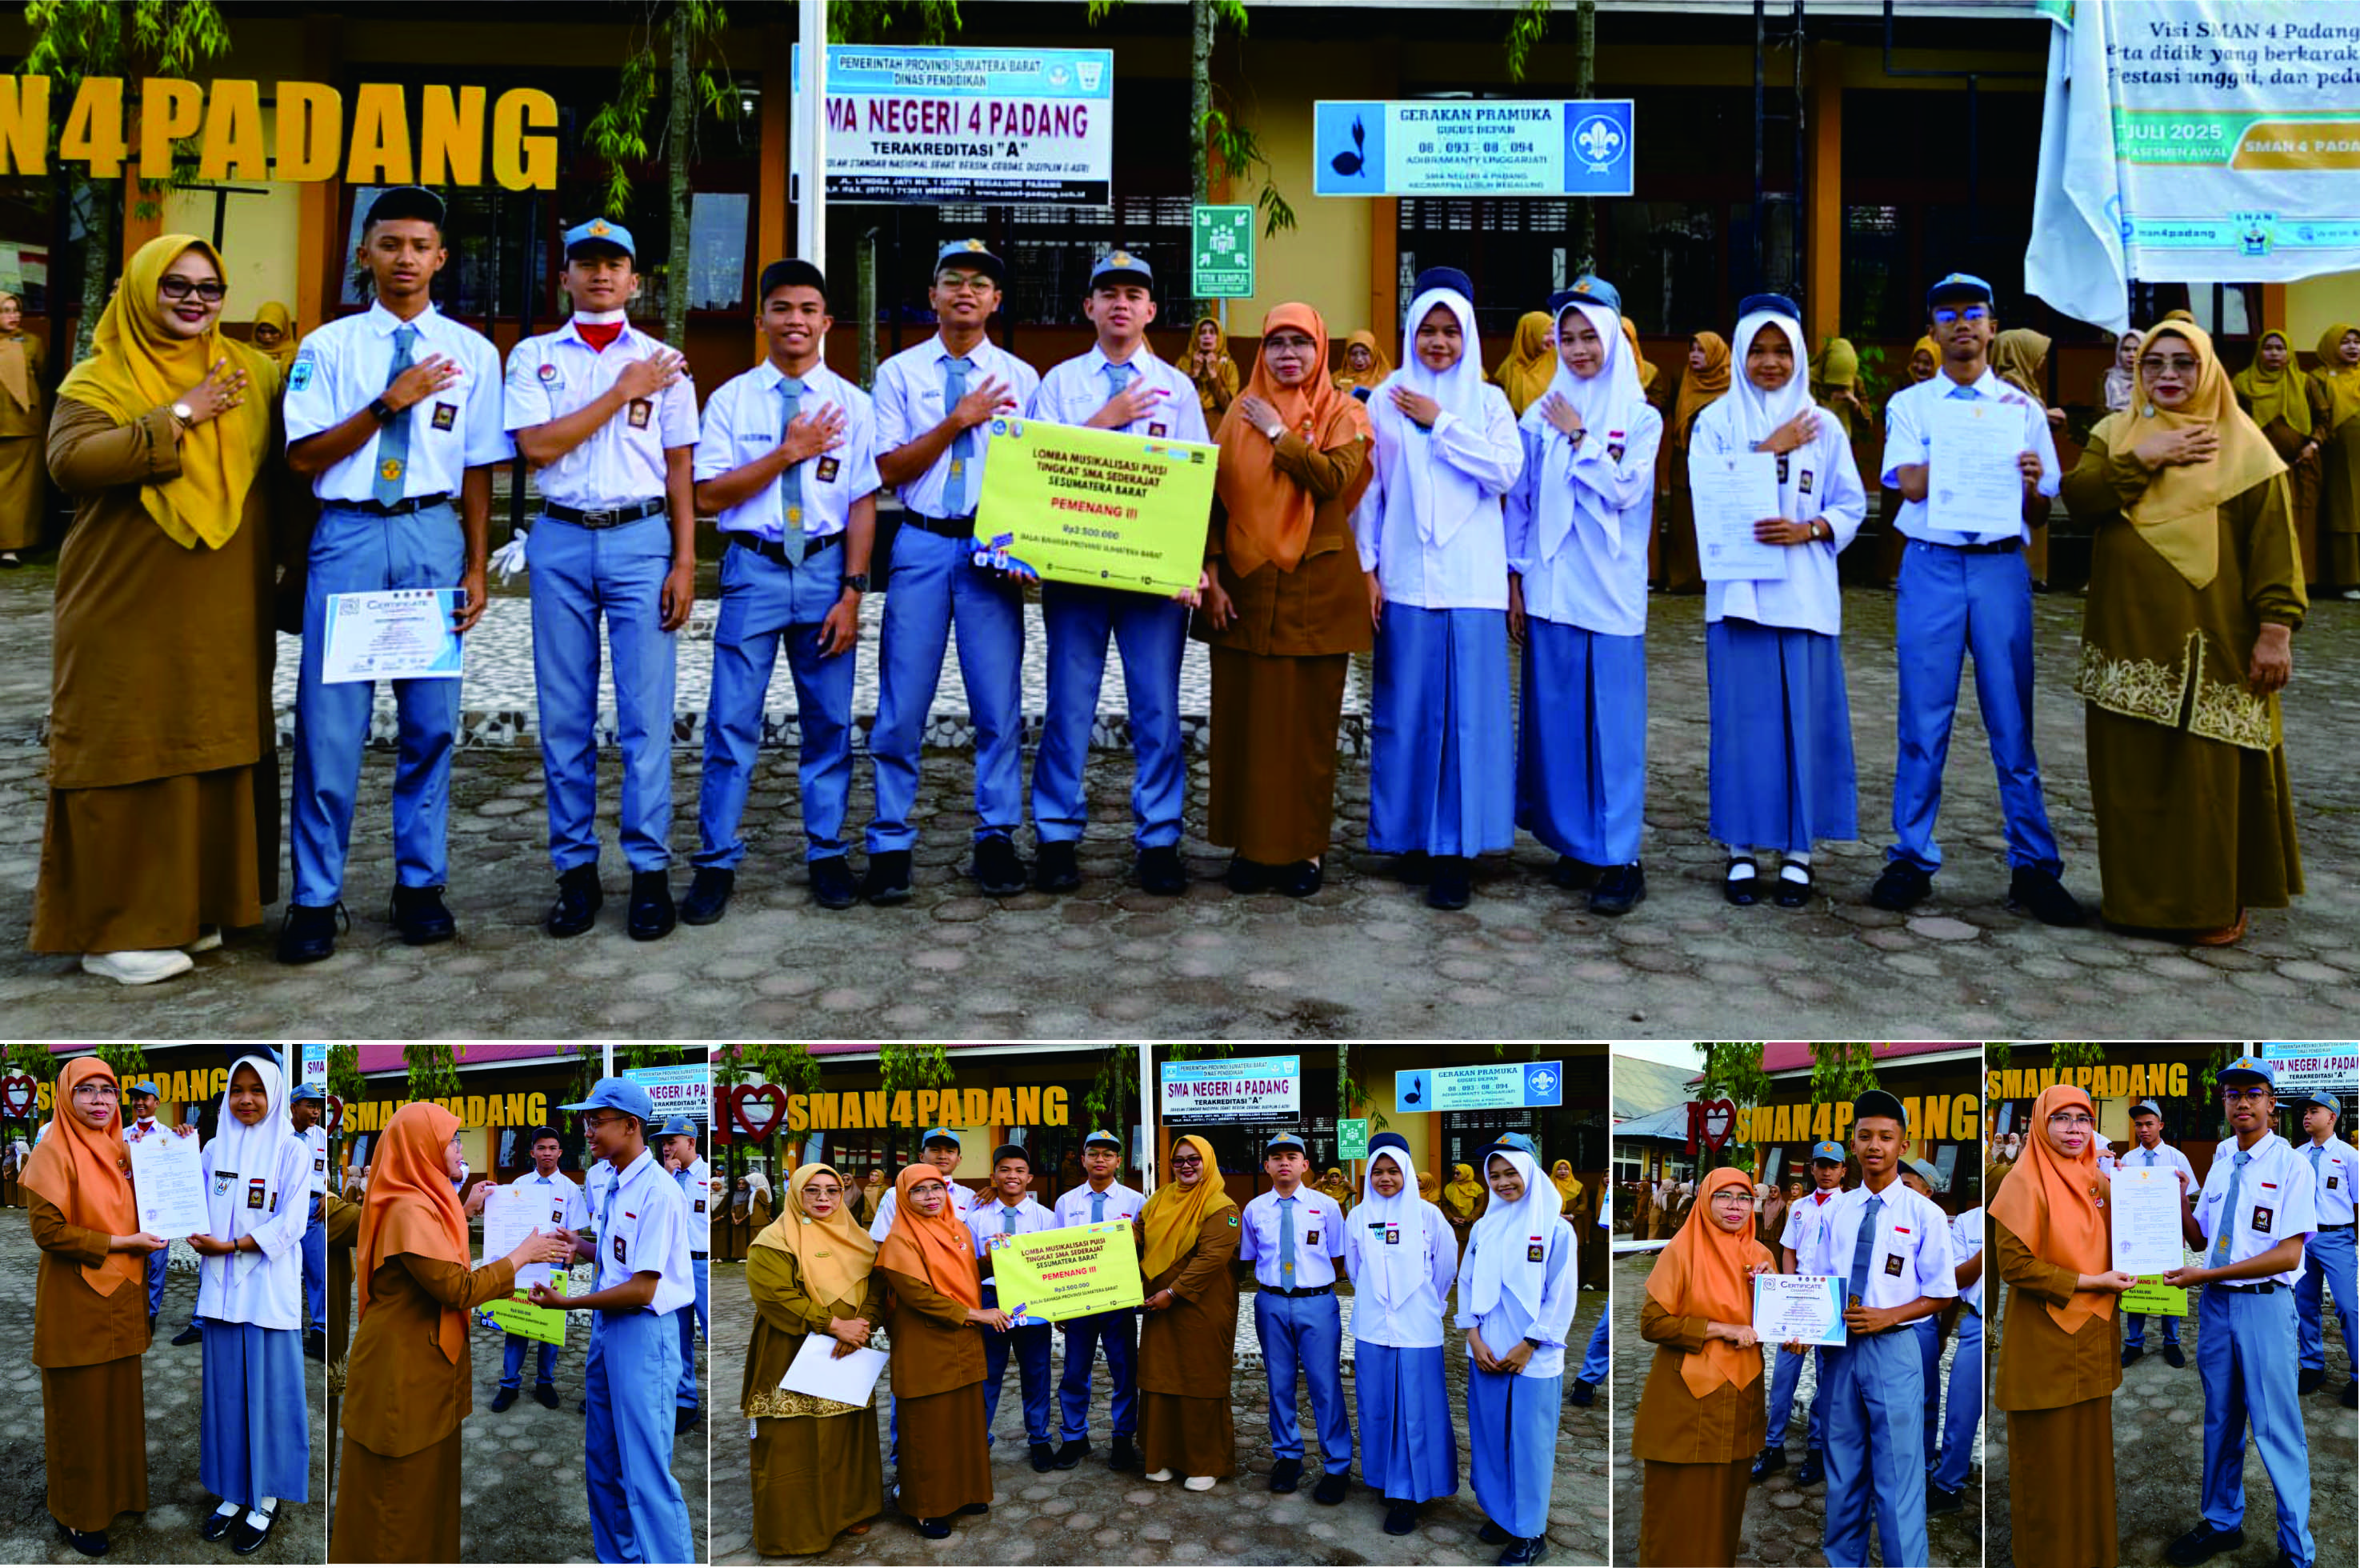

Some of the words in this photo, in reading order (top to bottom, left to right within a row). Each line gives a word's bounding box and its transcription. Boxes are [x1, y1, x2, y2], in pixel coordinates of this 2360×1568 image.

[2150, 21, 2188, 38] Visi
[2196, 22, 2259, 38] SMAN
[2266, 22, 2277, 38] 4
[2285, 22, 2360, 42] Padang
[2150, 44, 2202, 61] didik
[2210, 49, 2258, 66] yang
[2265, 45, 2359, 61] berkarak
[840, 56, 902, 70] PEMERINTAH
[904, 58, 951, 71] PROVINSI
[954, 59, 1006, 72] SUMATERA
[1010, 60, 1041, 72] BARAT
[894, 73, 923, 86] DINAS
[926, 74, 986, 87] PENDIDIKAN
[2186, 68, 2263, 90] unggul,
[2270, 68, 2308, 84] dan
[826, 97, 858, 134] MA
[869, 98, 959, 135] NEGERI
[968, 101, 981, 135] 4
[990, 102, 1088, 138] PADANG
[1400, 108, 1472, 121] GERAKAN
[1476, 108, 1552, 121] PRAMUKA
[1437, 125, 1474, 134] GUGUS
[1477, 125, 1515, 134] DEPAN
[2128, 124, 2165, 139] JULI
[2170, 124, 2222, 139] 2025
[870, 141, 994, 158] TERAKREDITASI
[997, 140, 1029, 158] "A"
[2245, 140, 2294, 152] SMAN
[1033, 448, 1067, 462] LOMBA
[1070, 453, 1139, 471] MUSIKALISASI
[1142, 463, 1168, 476] PUISI
[1037, 461, 1079, 476] TINGKAT
[1082, 468, 1103, 480] SMA
[1106, 470, 1161, 486] SEDERAJAT
[1048, 475, 1113, 494] SESUMATERA
[1115, 485, 1148, 498] BARAT
[1050, 497, 1123, 518] PEMENANG
[1126, 506, 1138, 519] III
[307, 1060, 325, 1074] SMA
[1438, 1070, 1476, 1078] GERAKAN
[1478, 1067, 1518, 1075] PRAMUKA
[2288, 1058, 2321, 1072] NEGERI
[2323, 1058, 2329, 1070] 4
[650, 1085, 683, 1099] NEGERI
[686, 1084, 691, 1098] 4
[1168, 1082, 1189, 1098] SMA
[1193, 1081, 1232, 1097] NEGERI
[1235, 1081, 1242, 1095] 4
[1245, 1079, 1289, 1095] PADANG
[653, 1099, 697, 1107] ERAKREDITASI
[1195, 1098, 1247, 1106] TERAKREDITASI
[1021, 1246, 1044, 1256] LOMBA
[1046, 1240, 1089, 1253] MUSIKALISASI
[1090, 1238, 1106, 1246] PUISI
[1026, 1253, 1054, 1263] TINGKAT
[1055, 1250, 1069, 1258] SMA
[1070, 1246, 1103, 1256] SEDERAJAT
[1036, 1257, 1077, 1269] SESUMATERA
[1078, 1254, 1098, 1262] BARAT
[1042, 1267, 1087, 1282] PEMENANG
[1089, 1266, 1097, 1274] III
